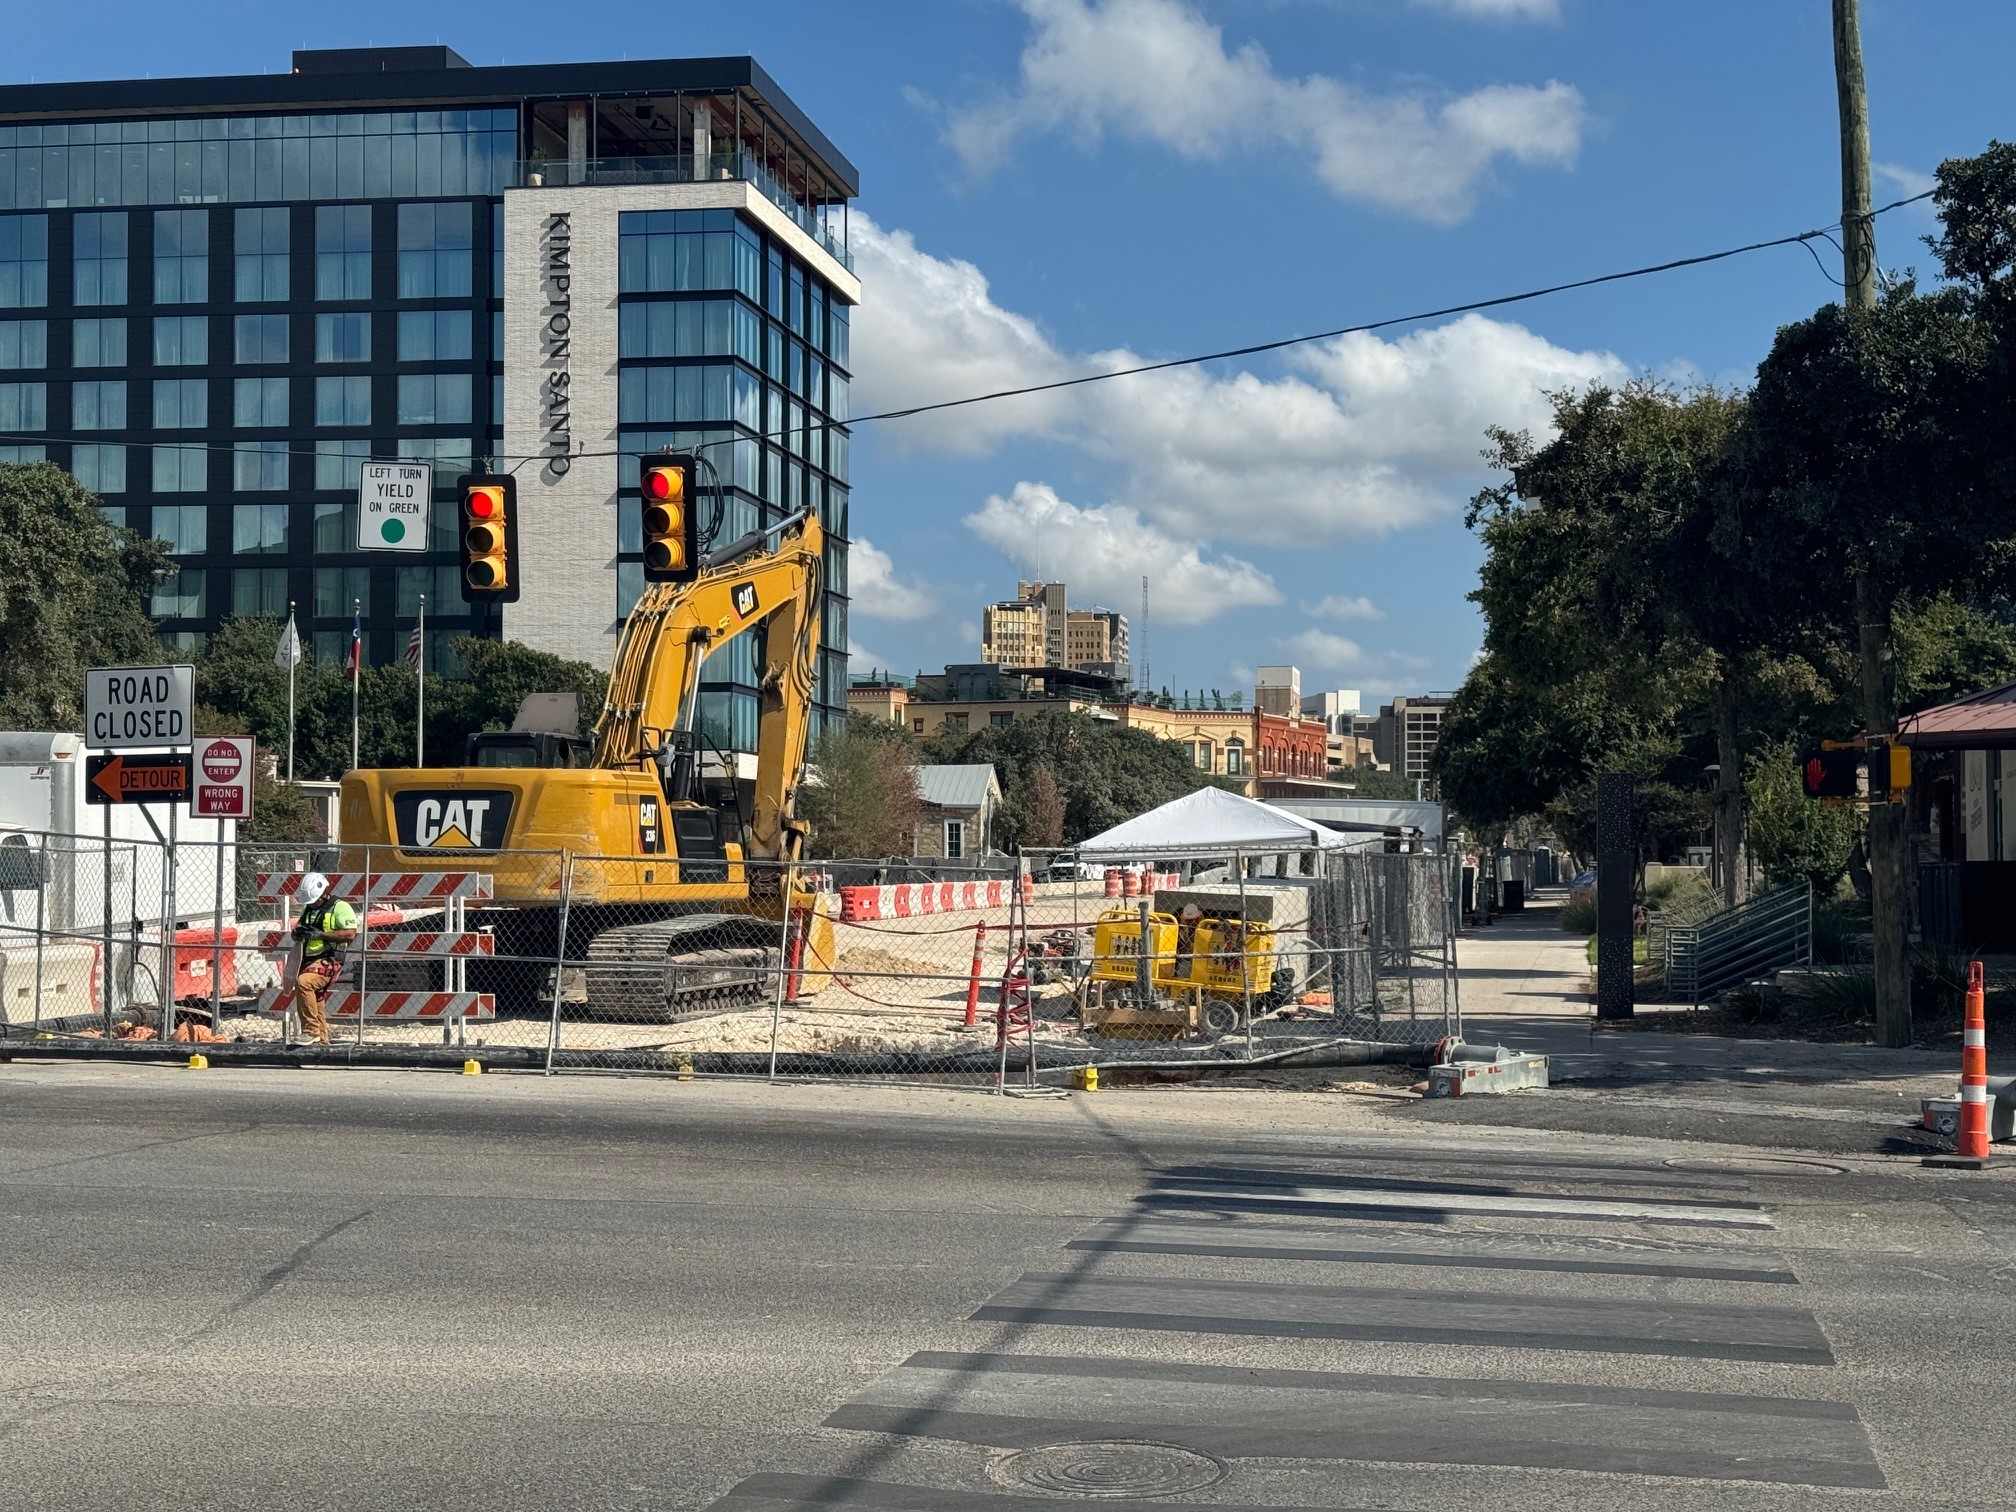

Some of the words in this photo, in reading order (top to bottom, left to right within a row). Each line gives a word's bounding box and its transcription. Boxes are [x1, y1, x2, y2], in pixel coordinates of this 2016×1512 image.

[550, 212, 571, 358] KIMPTON
[550, 371, 571, 476] SANTO
[369, 467, 392, 479] LEFT
[399, 468, 422, 480] TURN
[377, 483, 414, 498] YIELD
[369, 501, 382, 513] ON
[389, 502, 419, 514] GREEN
[738, 585, 754, 615] CAT
[108, 675, 169, 705] ROAD
[94, 709, 183, 740] CLOSED
[207, 749, 219, 757] DO
[220, 749, 237, 757] NOT
[120, 769, 181, 789] DETOUR
[208, 768, 235, 776] ENTER
[204, 788, 238, 798] WRONG
[210, 801, 231, 811] WAY
[640, 803, 657, 827] CAT
[416, 799, 490, 847] CAT
